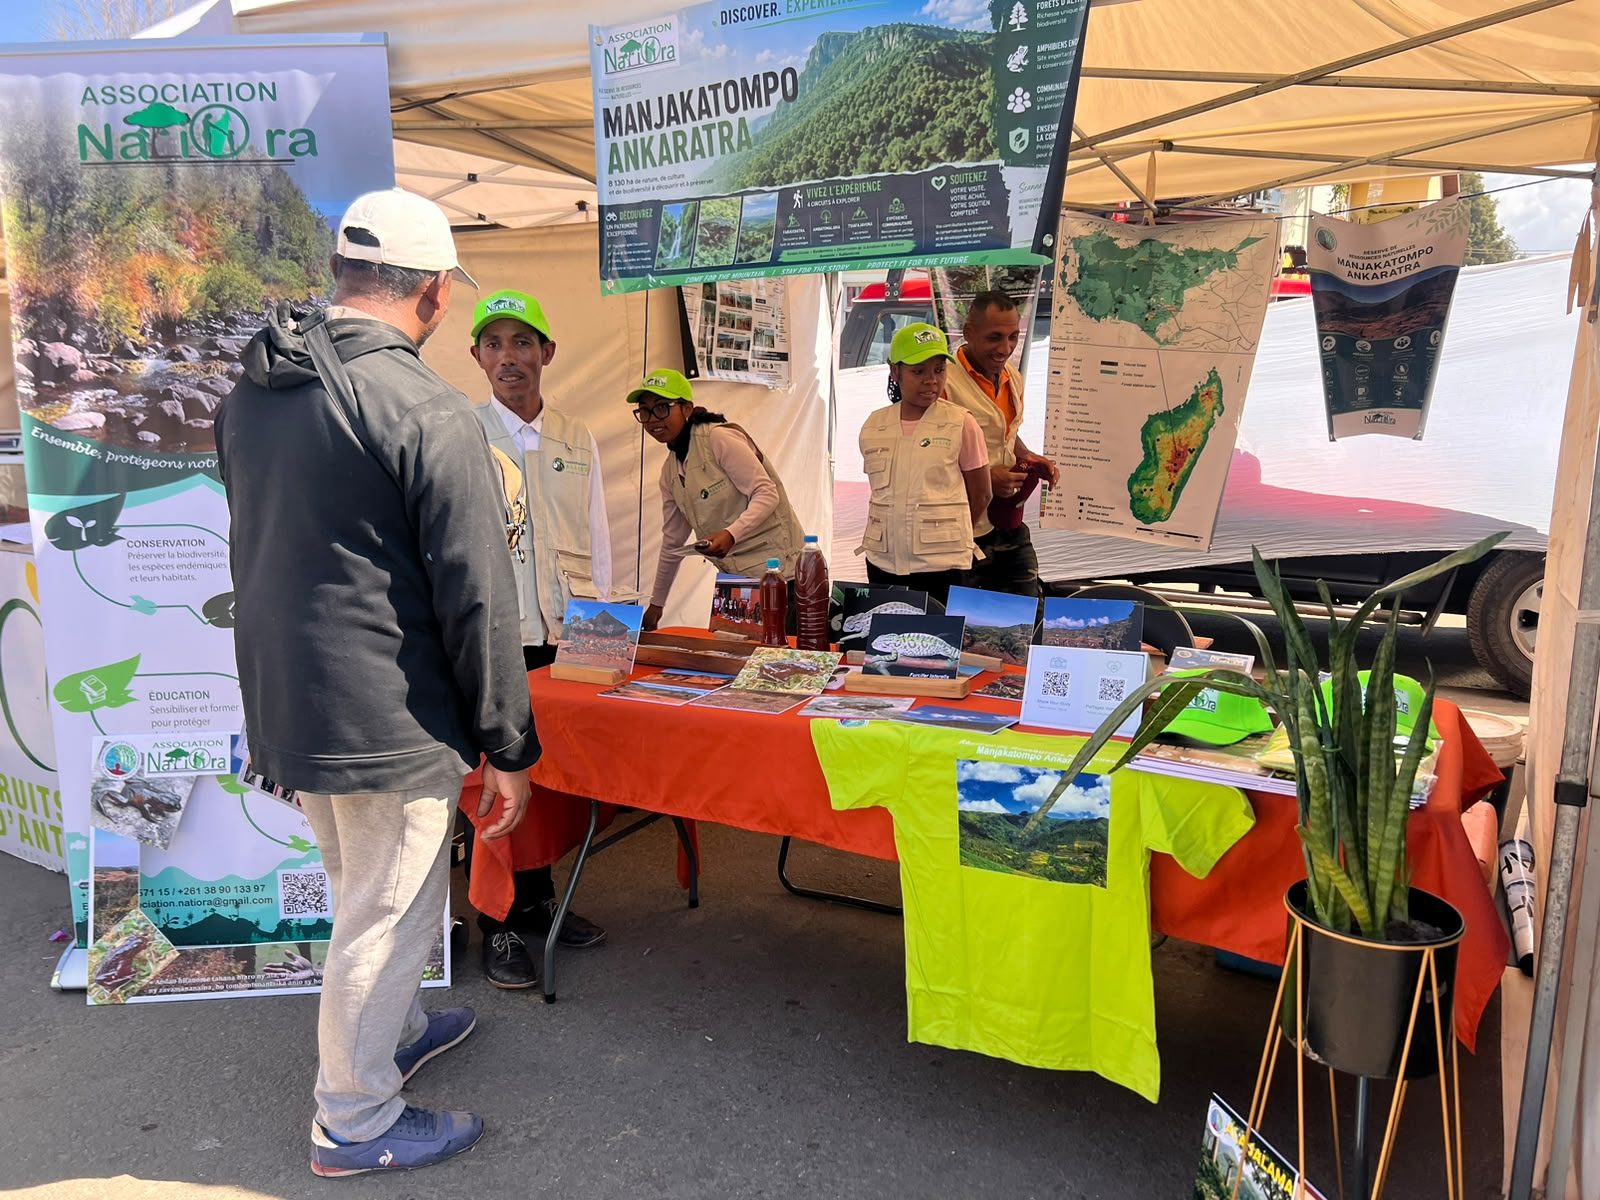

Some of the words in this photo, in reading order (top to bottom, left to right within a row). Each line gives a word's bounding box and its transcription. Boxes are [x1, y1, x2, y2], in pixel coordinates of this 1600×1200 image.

[720, 2, 781, 26] DISCOVER.
[1036, 18, 1067, 28] biodiversité
[608, 22, 672, 44] ASSOCIATION
[1036, 41, 1068, 53] AMPHIBIENS
[1036, 54, 1047, 62] Site
[80, 81, 278, 106] ASSOCIATION
[603, 66, 799, 139] MANJAKATOMPO
[1036, 134, 1043, 142] LA
[608, 117, 753, 175] ANKARATRA
[614, 178, 625, 186] 130
[950, 171, 987, 185] SOUTENEZ
[806, 186, 827, 199] VIVEZ
[950, 186, 967, 194] VOTRE
[836, 197, 860, 205] EXPLORER
[950, 194, 967, 202] VOTRE
[968, 200, 991, 208] SOUTIEN
[1337, 246, 1433, 271] MANJAKATOMPO
[704, 274, 717, 282] FOR
[732, 271, 765, 279] MOUNTAIN
[798, 266, 812, 274] FOR
[867, 260, 898, 268] PROTECT
[1347, 261, 1421, 280] ANKARATRA
[31, 426, 102, 459] Ensemble,
[105, 451, 185, 469] protégeons
[188, 458, 219, 469] notr
[126, 539, 206, 548] CONSERVATION
[128, 552, 166, 560] Préserver
[168, 551, 175, 559] la
[177, 550, 227, 559] biodiversité,
[129, 563, 140, 571] les
[142, 563, 175, 572] espèces
[176, 561, 227, 571] endémiques
[162, 573, 197, 581] habitats.
[150, 704, 197, 714] Sensibiliser
[200, 705, 208, 713] et
[210, 703, 239, 712] former
[151, 720, 171, 728] pour
[174, 717, 210, 728] protéger
[152, 740, 224, 749] ASSOCIATION
[976, 745, 1042, 761] Manjakatompo
[1044, 753, 1073, 764] Ankar
[158, 888, 170, 896] 15
[178, 886, 201, 896] +261
[204, 886, 216, 894] 38
[219, 885, 231, 894] 90
[234, 885, 251, 893] 133
[253, 884, 266, 892] 97
[1248, 1142, 1294, 1197] SALAMA
